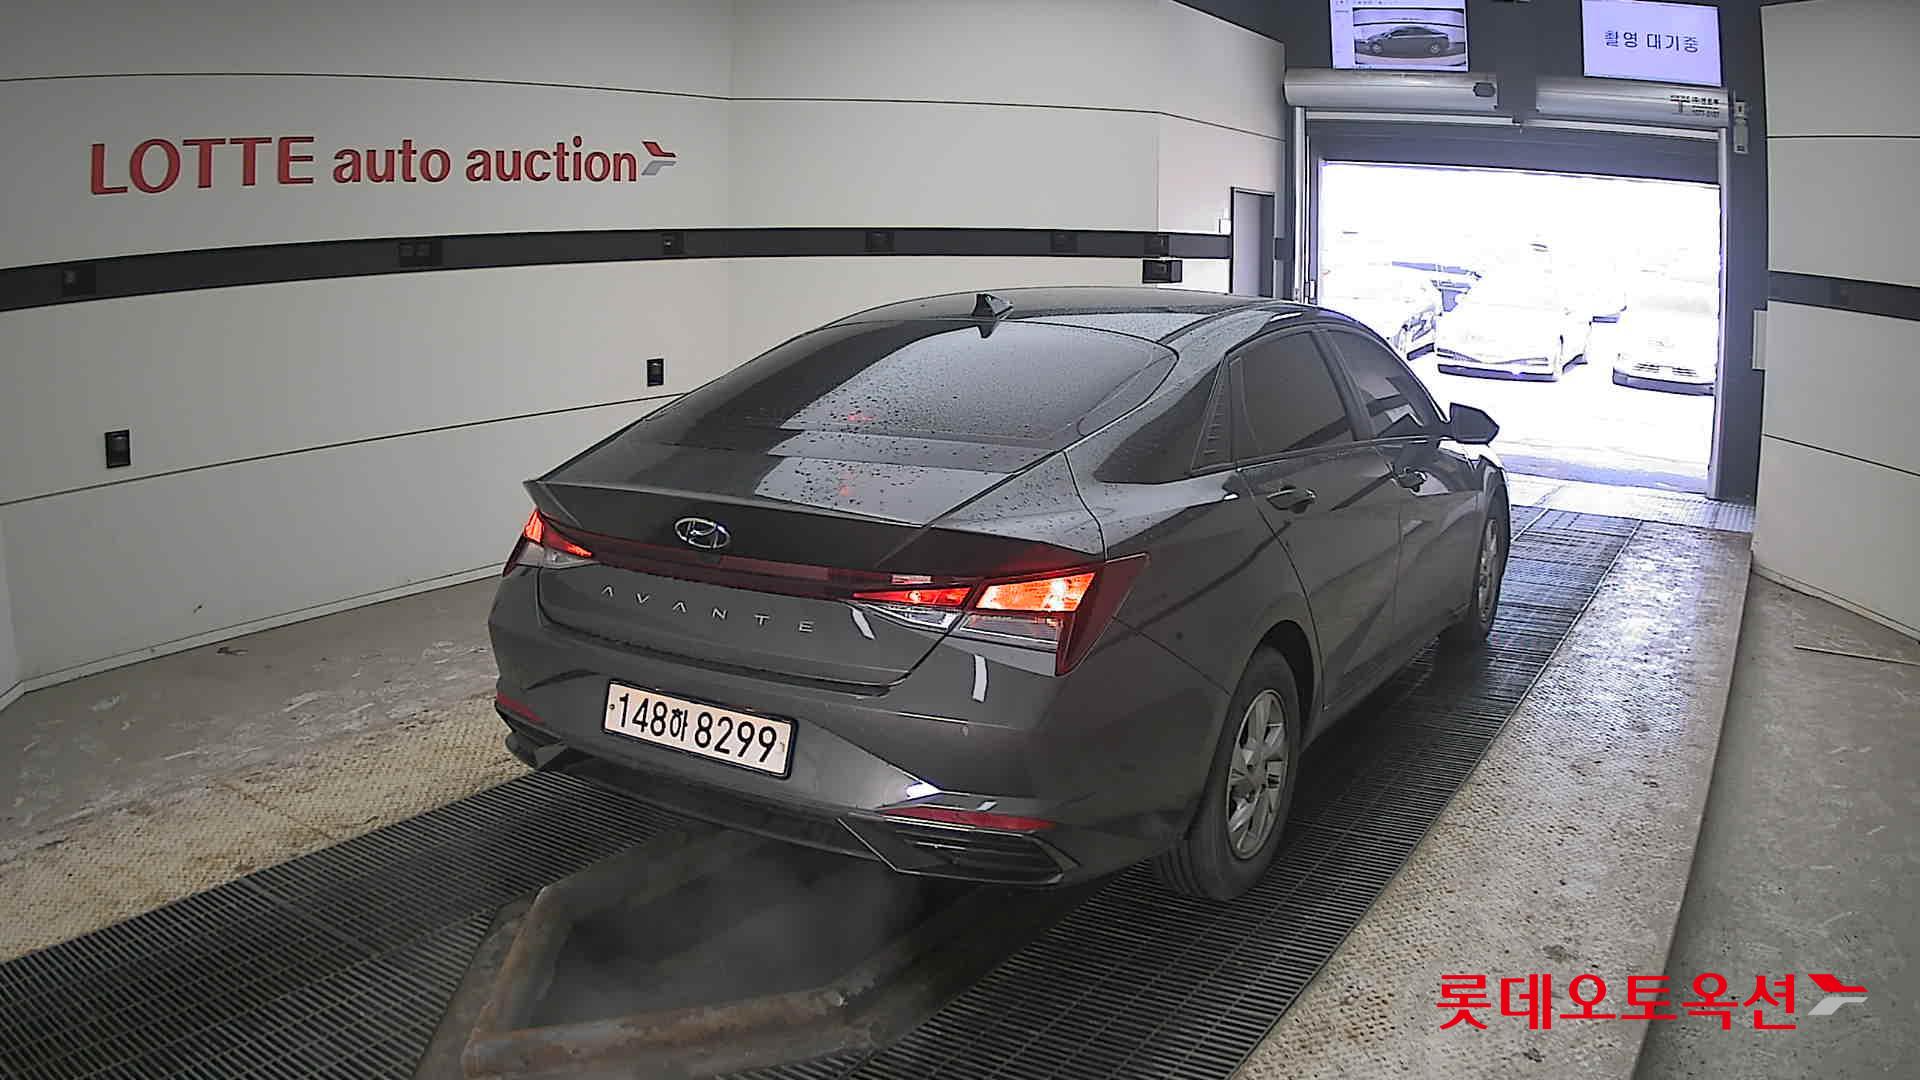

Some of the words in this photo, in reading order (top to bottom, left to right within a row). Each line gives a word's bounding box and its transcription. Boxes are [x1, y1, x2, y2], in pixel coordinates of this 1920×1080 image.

[1646, 32, 1698, 53] 대기중
[91, 136, 315, 195] LOTTE
[333, 138, 451, 183] auto
[465, 135, 638, 182] auction
[602, 584, 815, 633] AVANTE
